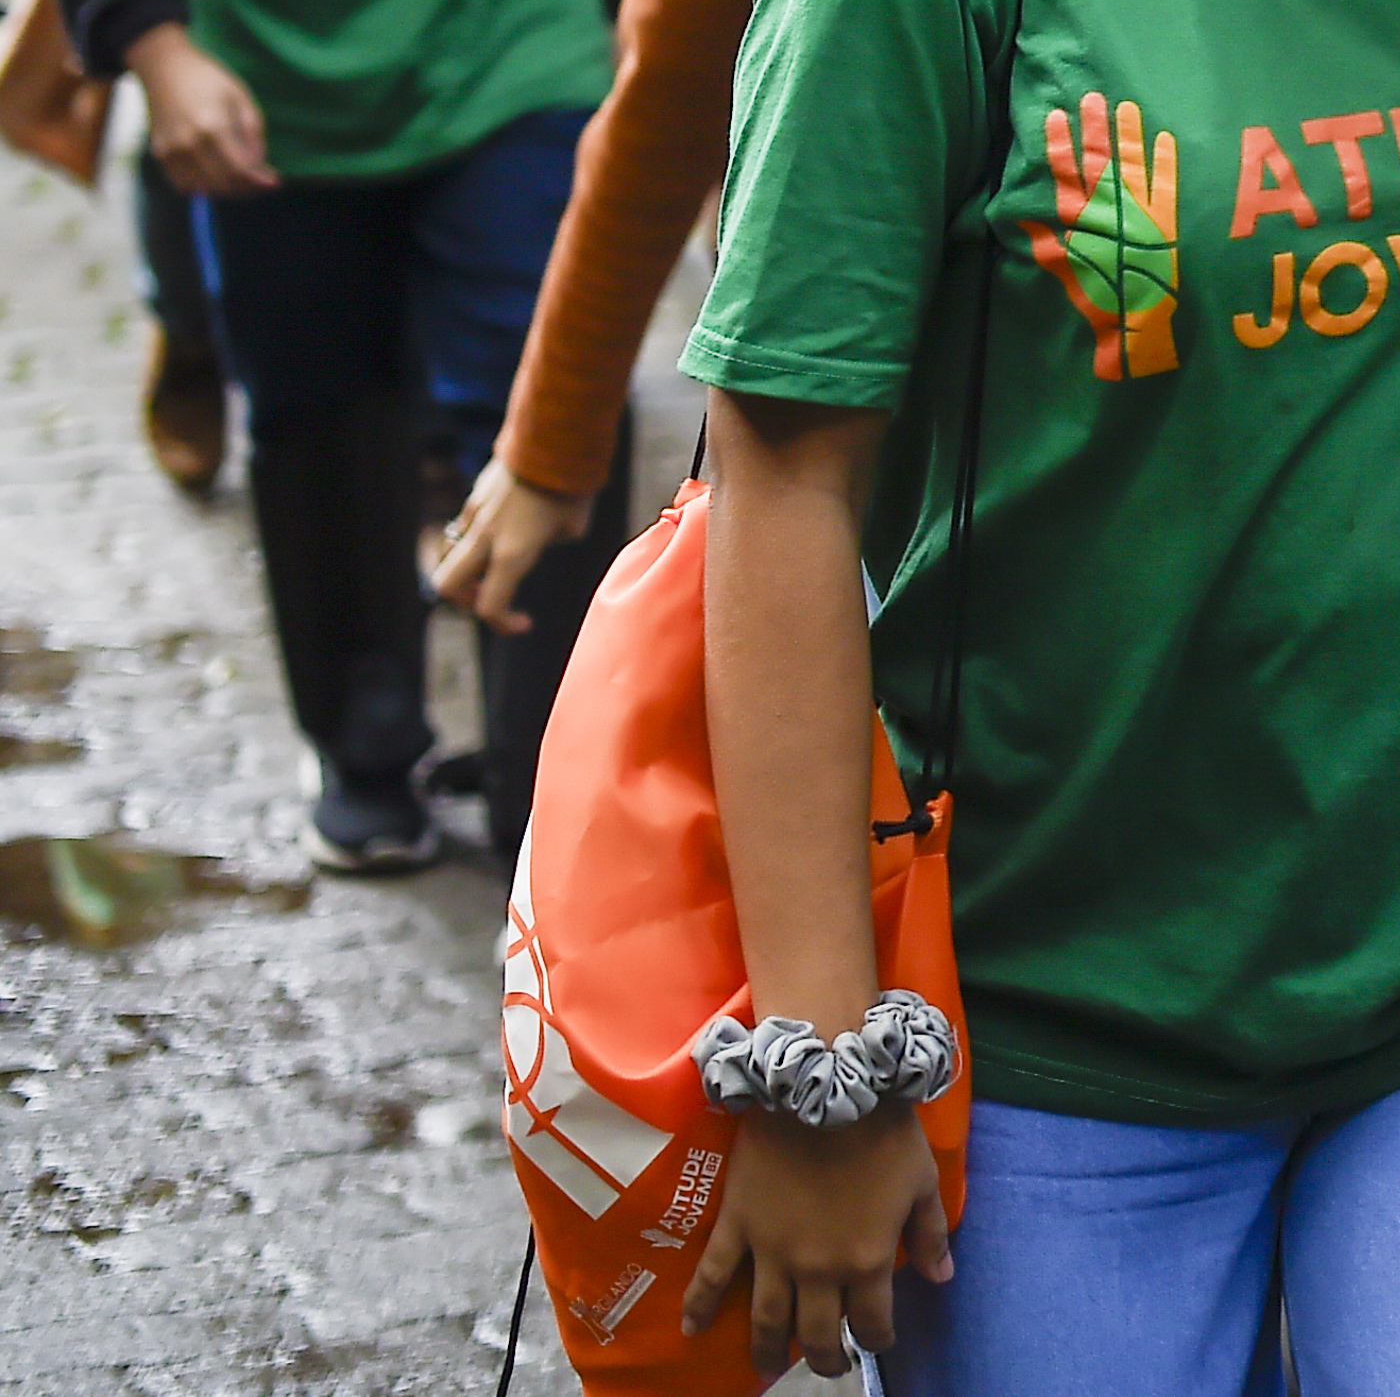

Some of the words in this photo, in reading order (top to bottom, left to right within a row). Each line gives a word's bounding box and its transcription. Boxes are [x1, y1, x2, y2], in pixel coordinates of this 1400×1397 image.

[659, 1148, 706, 1230] ATITUDE
[678, 1178, 715, 1235] JOVEM
[703, 1153, 721, 1175] BR
